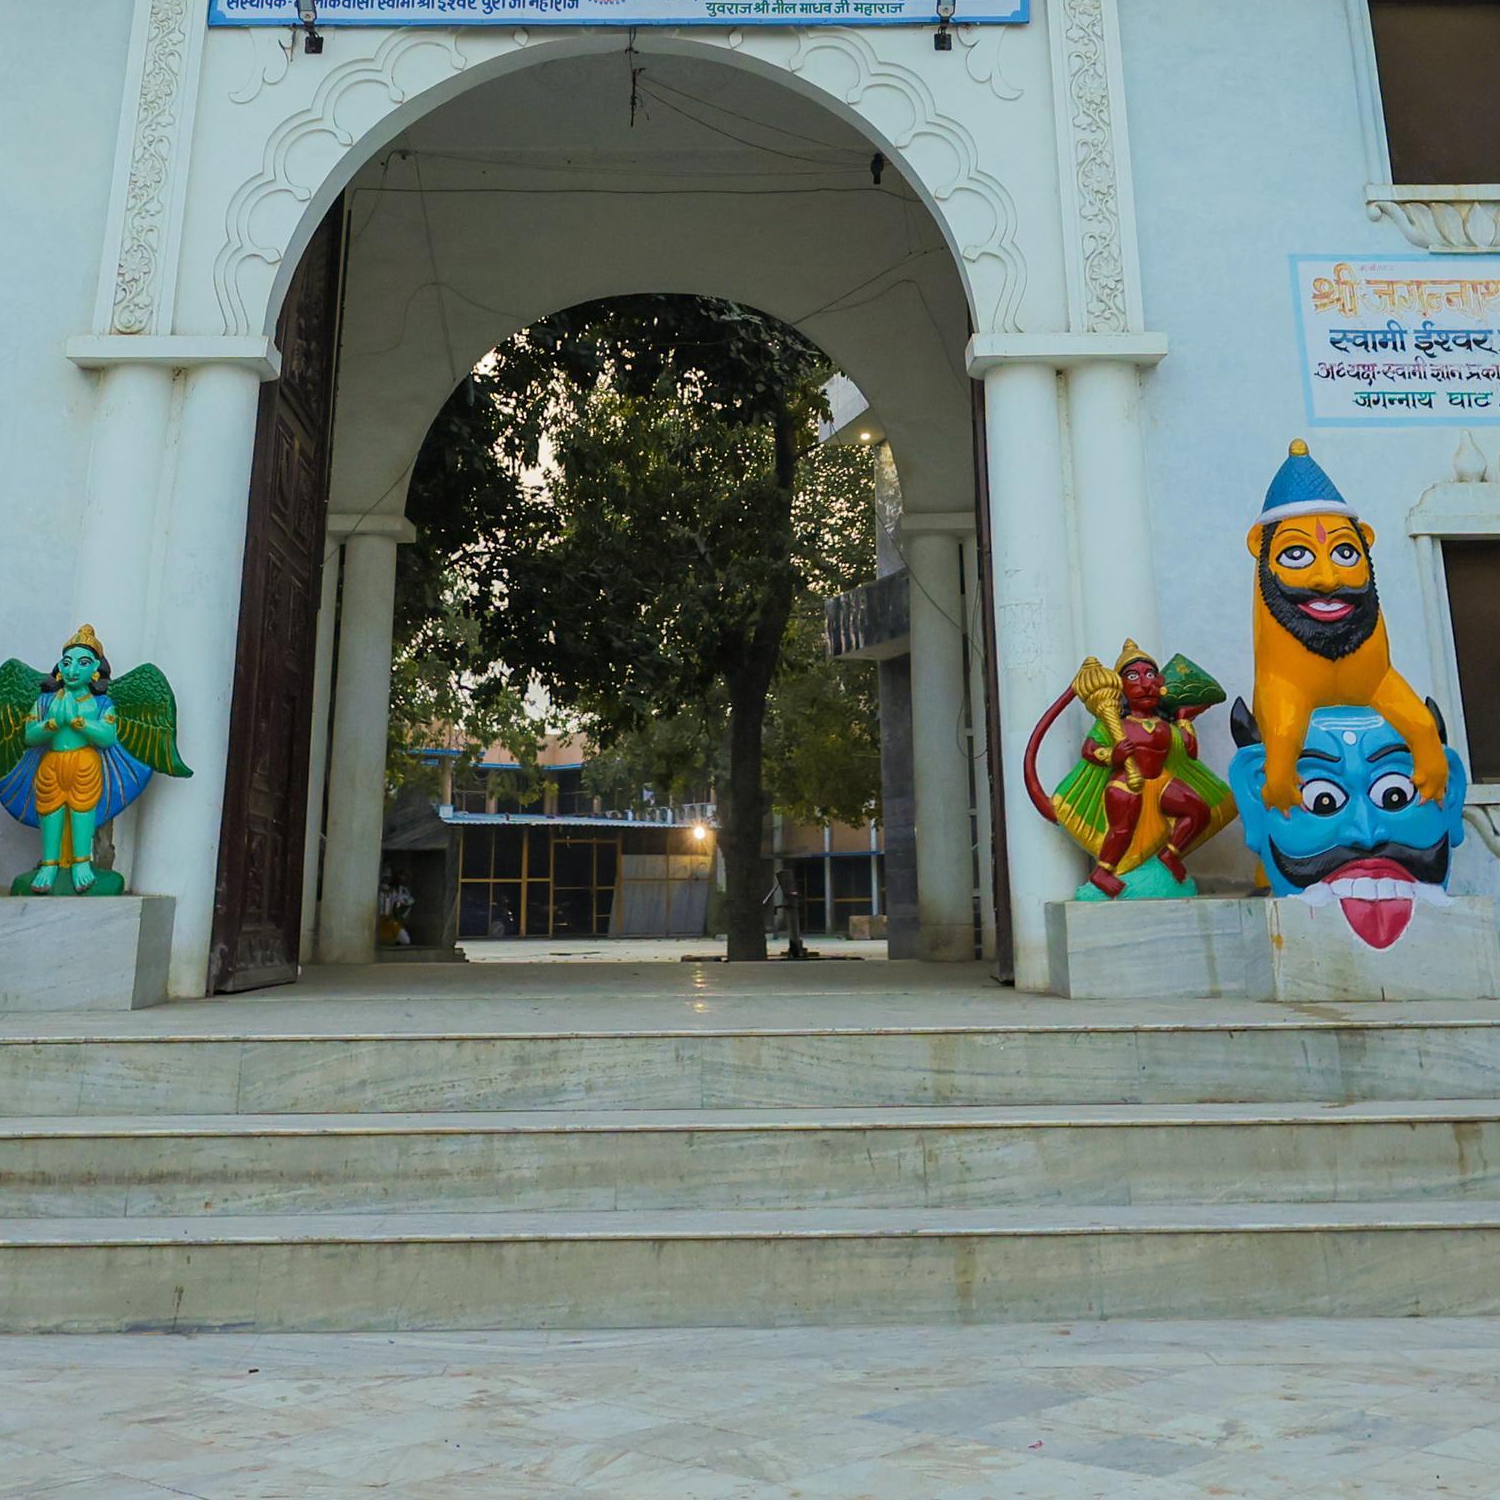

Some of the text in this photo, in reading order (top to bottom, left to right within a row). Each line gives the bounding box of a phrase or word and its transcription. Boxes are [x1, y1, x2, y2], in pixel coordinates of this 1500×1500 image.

[706, 1, 752, 17] युवराज
[753, 0, 771, 15] श्री
[772, 0, 797, 15] नील
[799, 2, 833, 15] माधव
[853, 2, 905, 17] महाराज
[1312, 263, 1359, 318] श्री
[1329, 319, 1408, 353] स्वामी
[1413, 320, 1499, 359] ईश्वर
[1430, 363, 1463, 382] ज्ञान
[1354, 391, 1437, 409] जगन्नाथ
